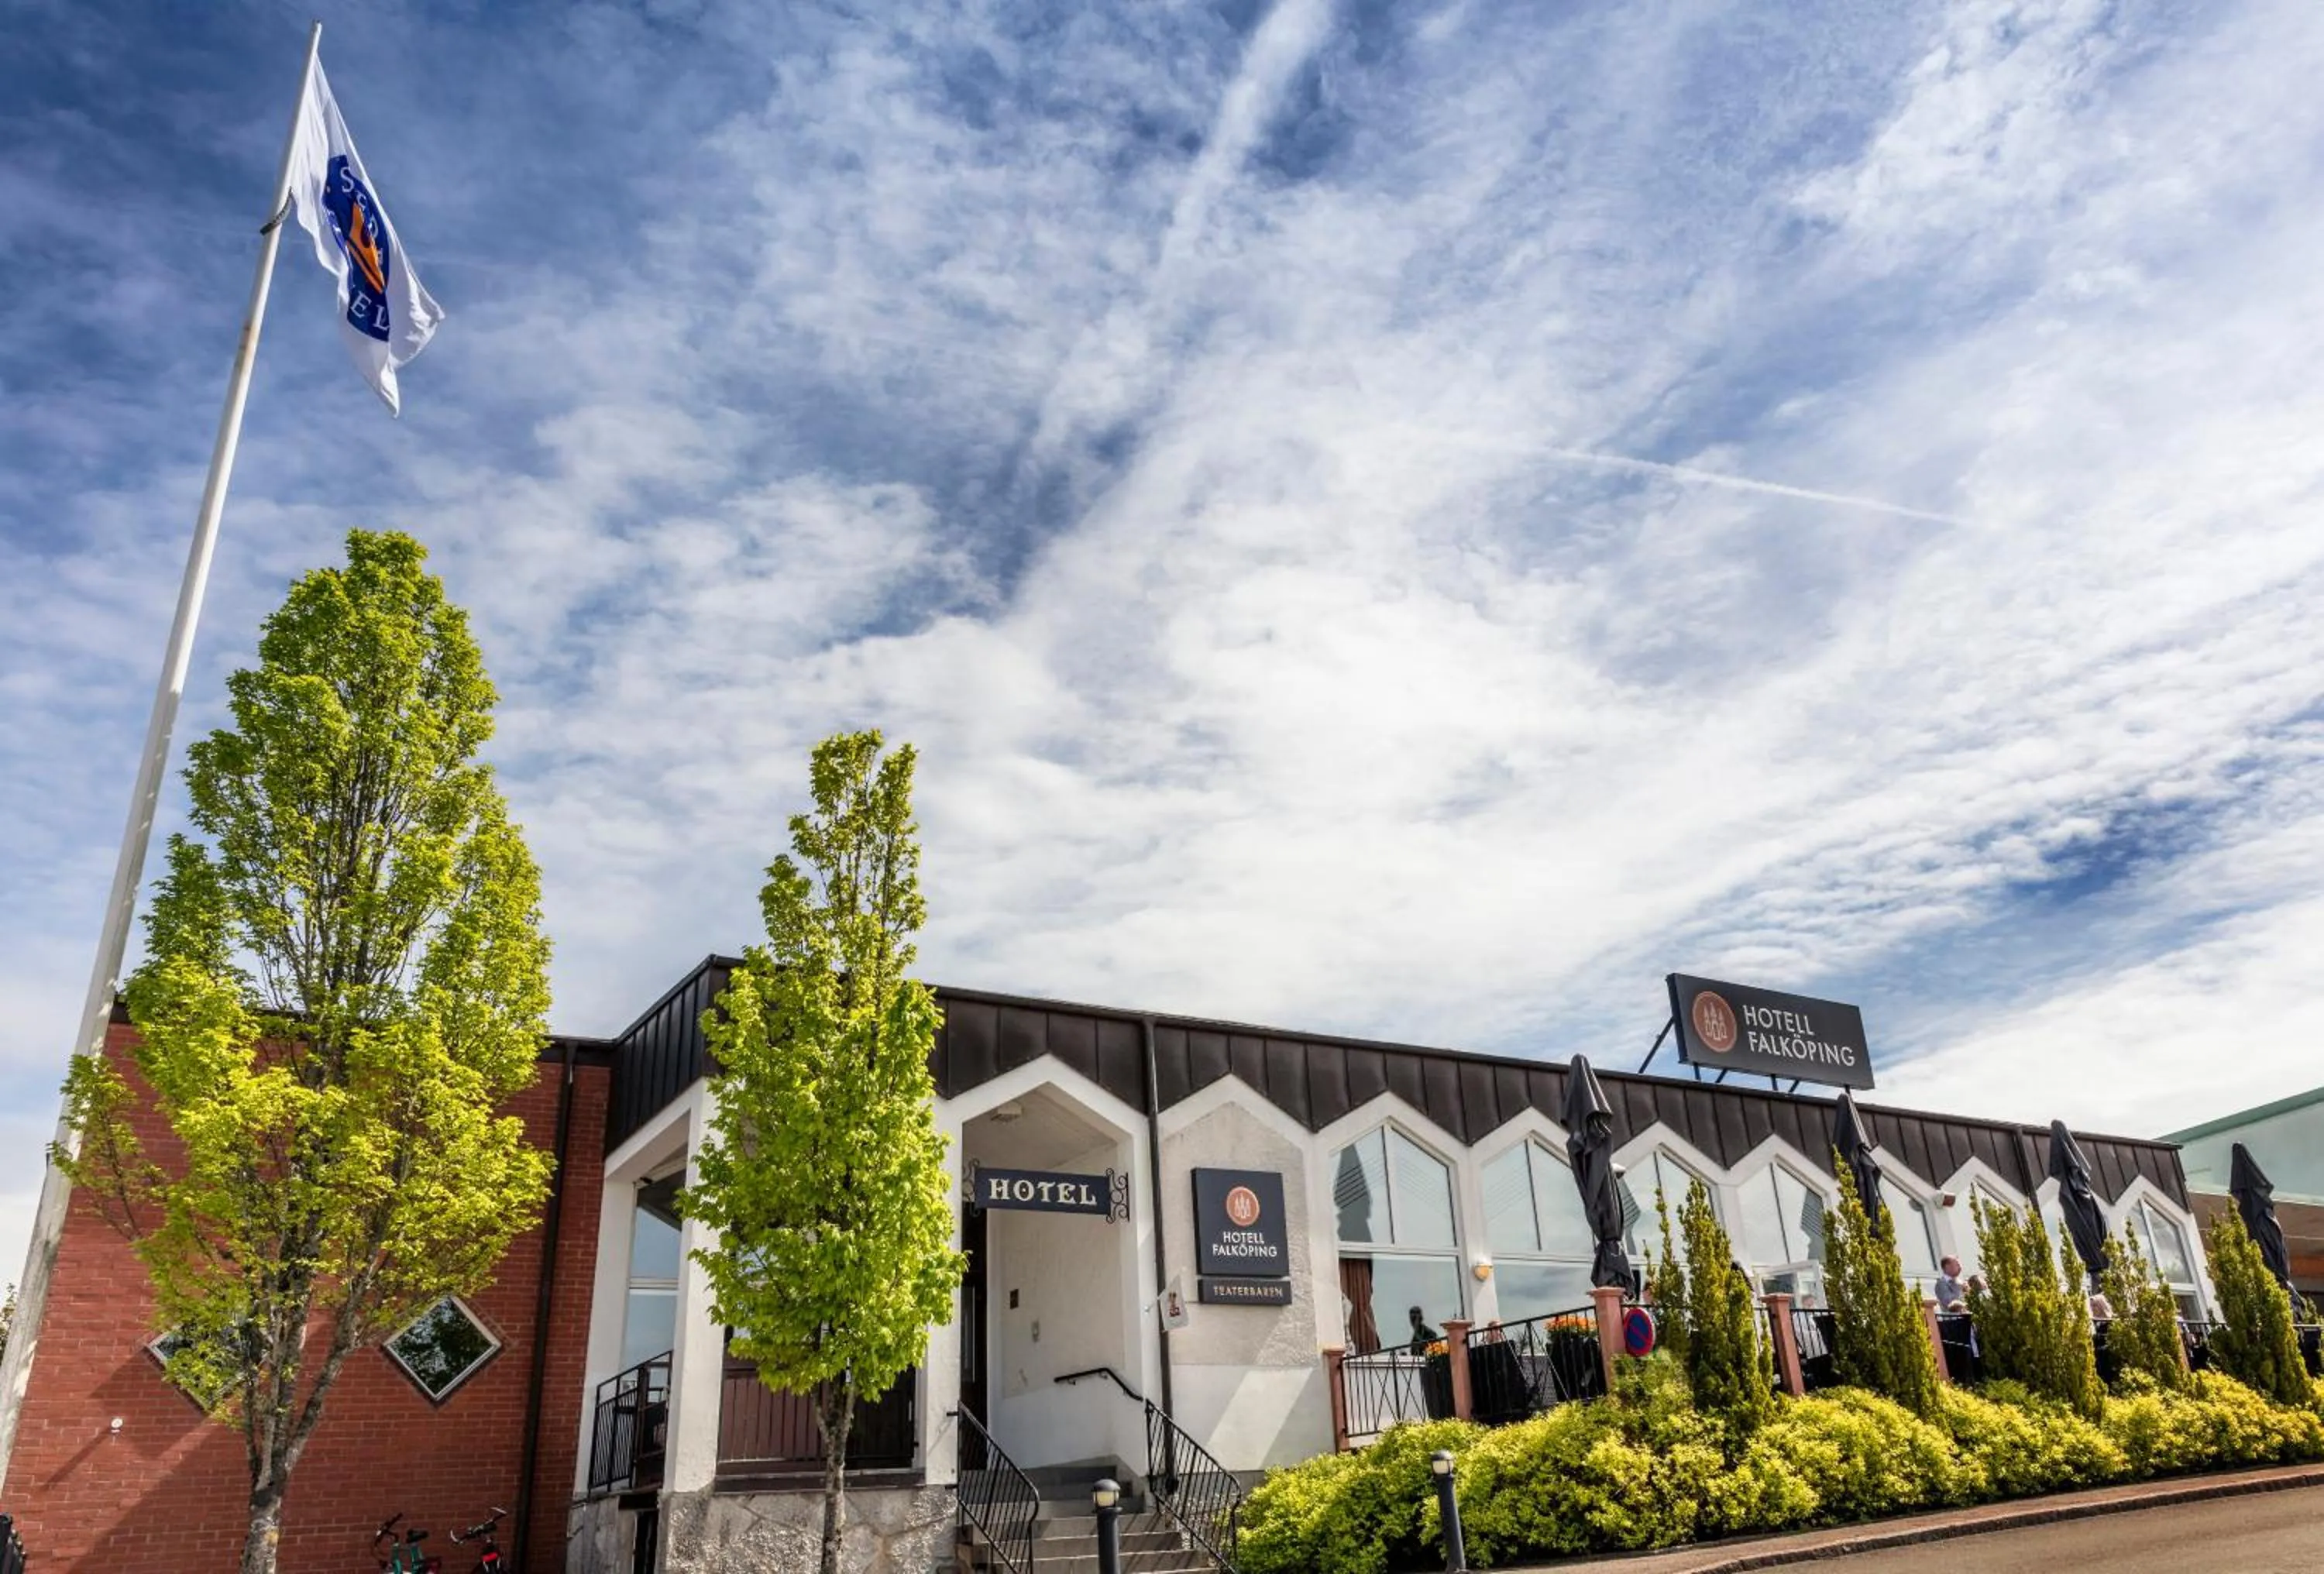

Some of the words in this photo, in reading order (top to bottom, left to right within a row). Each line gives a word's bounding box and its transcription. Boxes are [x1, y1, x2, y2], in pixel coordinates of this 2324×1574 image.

[1743, 1005, 1814, 1036] HOTELL
[1748, 1031, 1855, 1067] FALKÖPING
[988, 1178, 1097, 1205] HOTEL
[1212, 1243, 1277, 1257] FALKÖPING
[1223, 1231, 1264, 1244] HOTELL
